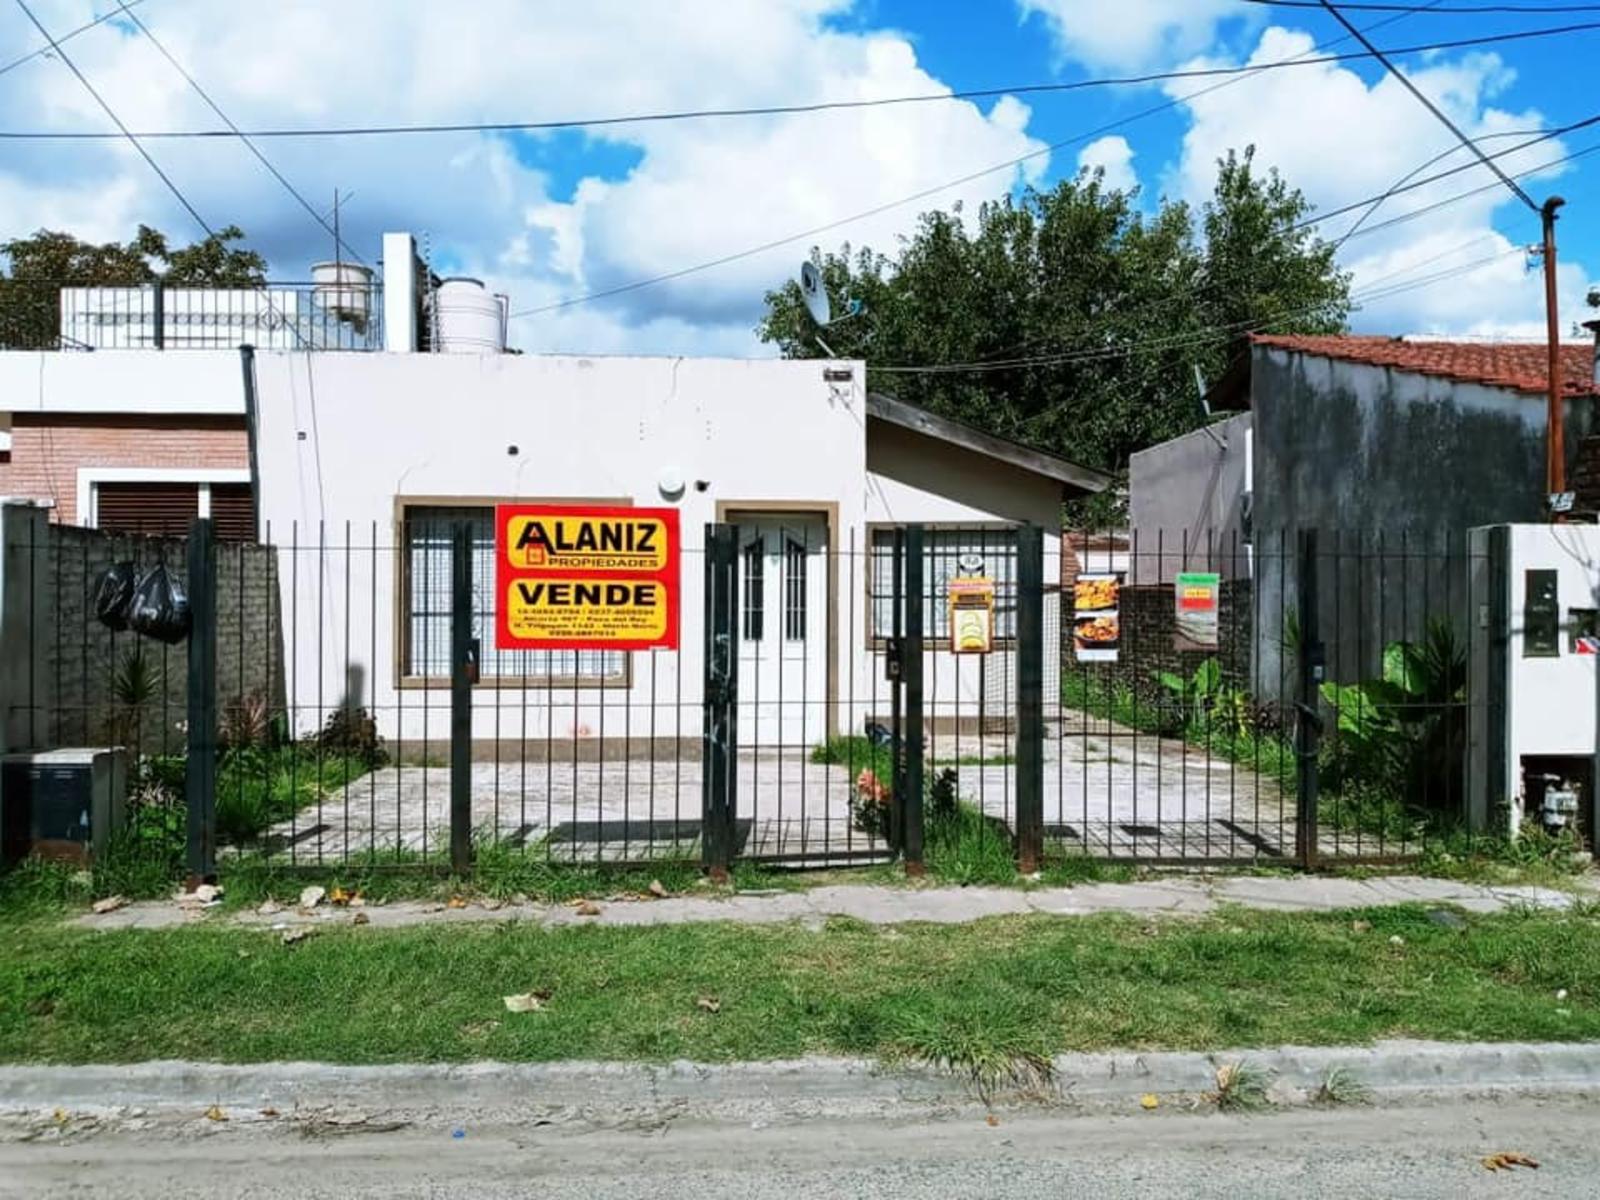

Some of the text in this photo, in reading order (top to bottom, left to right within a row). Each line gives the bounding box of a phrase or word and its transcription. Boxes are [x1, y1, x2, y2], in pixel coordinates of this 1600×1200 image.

[515, 521, 658, 555] ALANIZ
[548, 557, 659, 568] PROPIEDADES
[517, 583, 656, 606] VENDE
